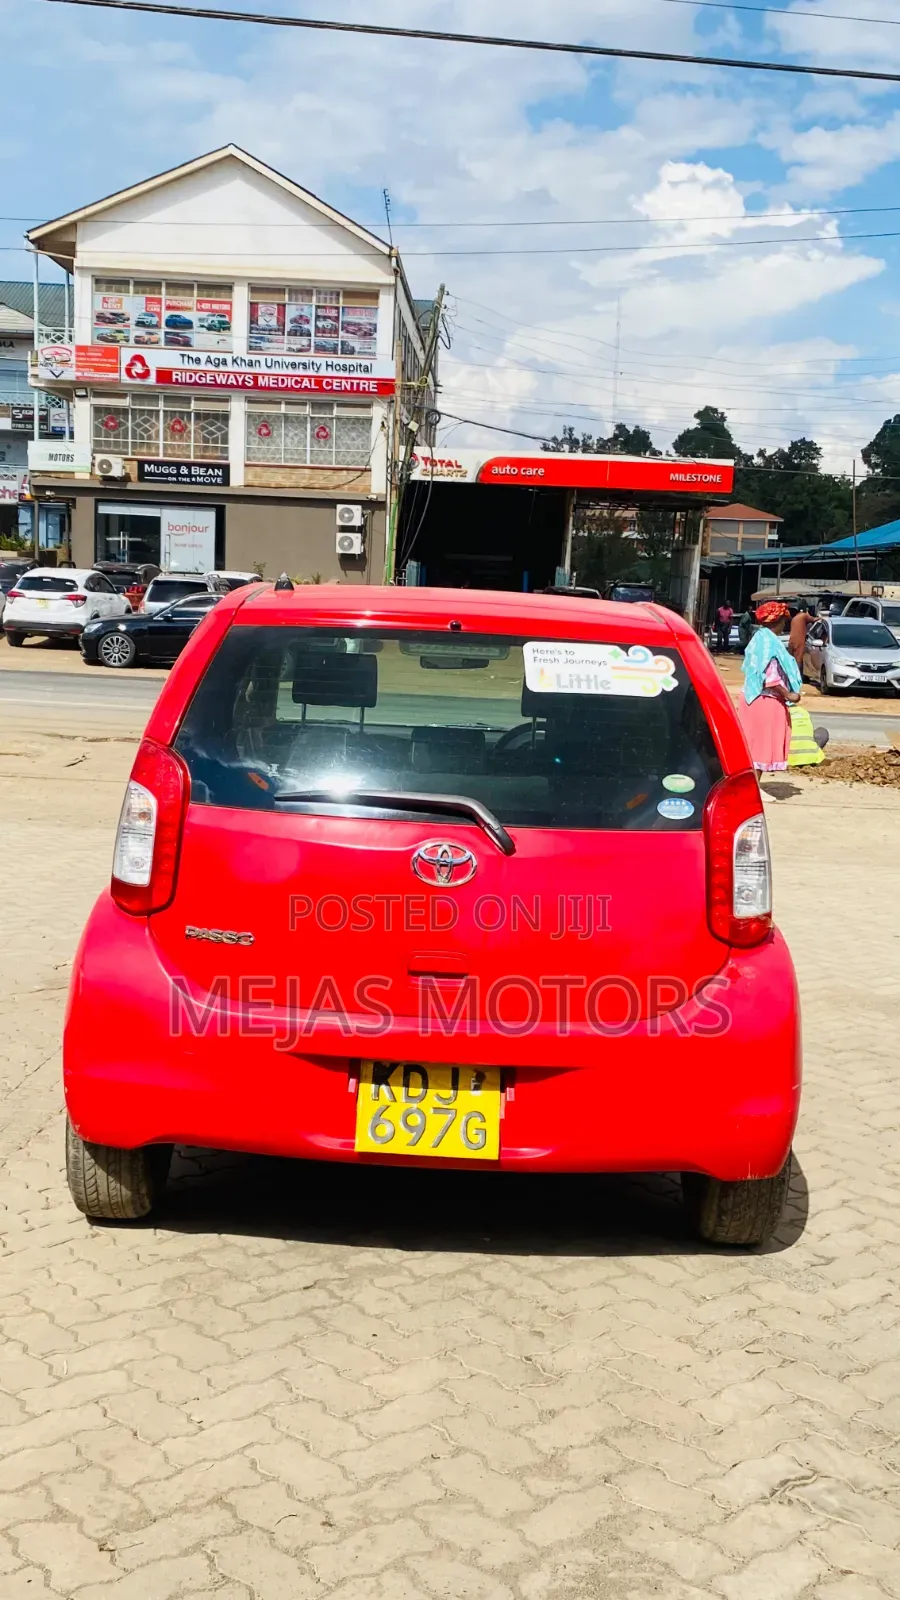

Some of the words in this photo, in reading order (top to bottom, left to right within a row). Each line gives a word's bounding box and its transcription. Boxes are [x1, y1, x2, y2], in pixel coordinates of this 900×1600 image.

[179, 354, 201, 366] The
[205, 355, 228, 369] Aga
[231, 356, 262, 368] Khan
[265, 357, 322, 374] University
[325, 360, 373, 375] Hospital
[172, 371, 254, 387] RIDGEWAYS
[258, 375, 319, 390] MEDICAL
[322, 379, 378, 392] CENTRE
[48, 452, 75, 462] MOTORS
[421, 456, 462, 468] TOTAL
[144, 464, 177, 474] MUGG
[179, 465, 189, 475] &
[191, 466, 223, 476] BEAN
[421, 468, 468, 478] QUARTZ
[491, 463, 518, 475] auto
[520, 466, 545, 477] care
[196, 476, 223, 484] MOVE
[669, 472, 722, 484] MILESTONE
[168, 520, 210, 535] bonjour
[532, 648, 562, 656] Here's
[533, 656, 560, 664] Fresh
[563, 657, 608, 667] Journeys
[556, 673, 612, 691] Little
[185, 925, 255, 946] PASSO
[371, 1061, 460, 1106] KDJ
[368, 1104, 487, 1151] 697G
